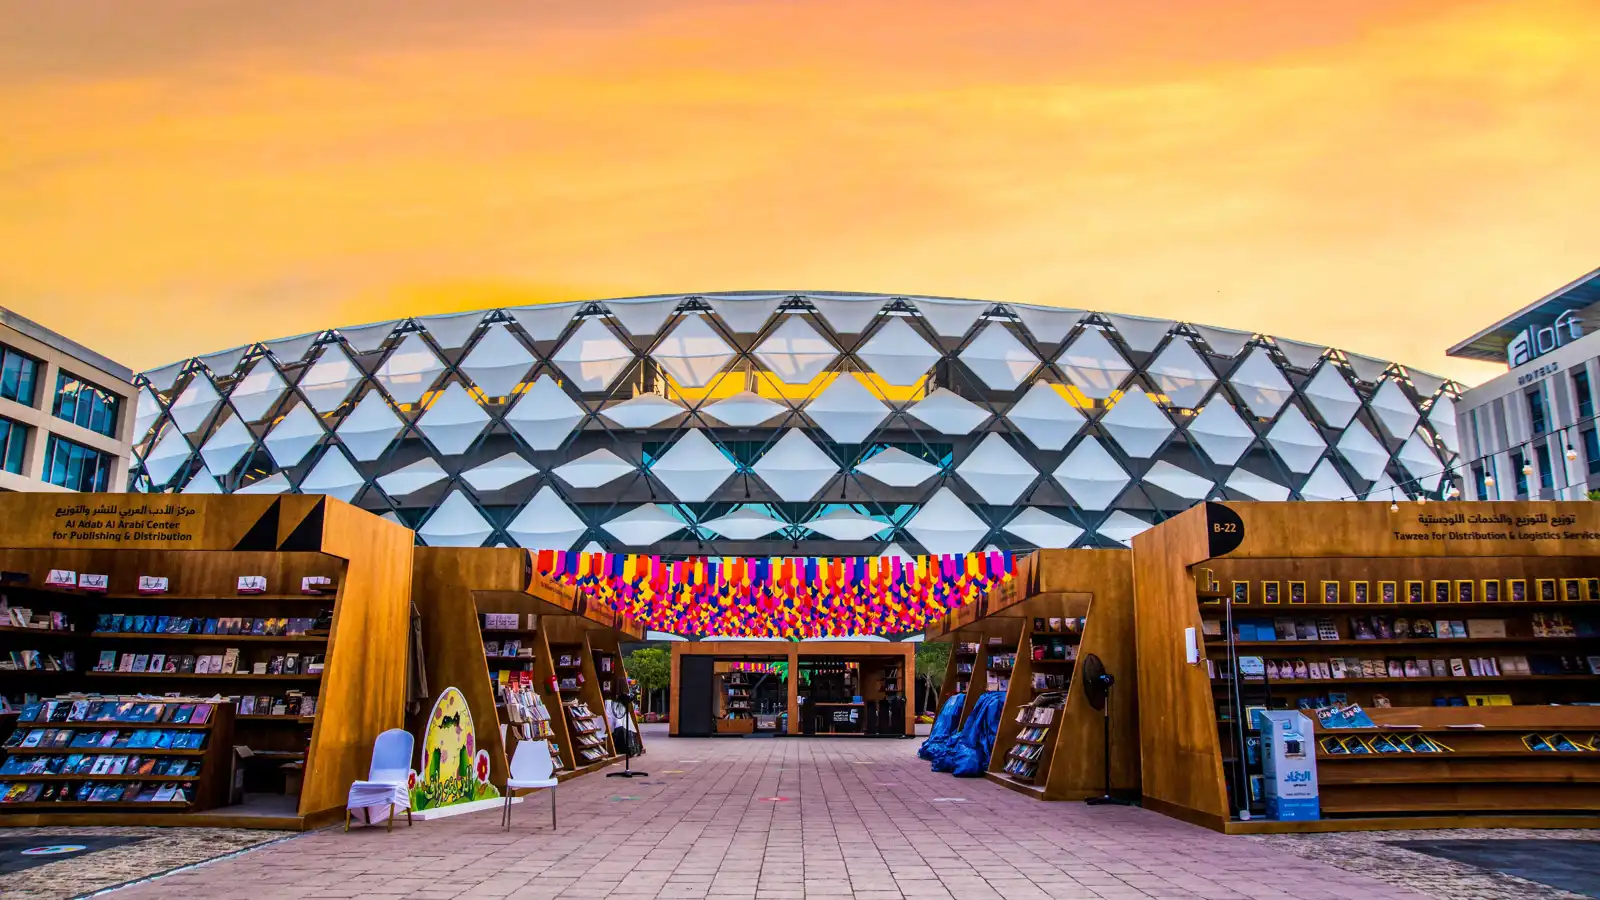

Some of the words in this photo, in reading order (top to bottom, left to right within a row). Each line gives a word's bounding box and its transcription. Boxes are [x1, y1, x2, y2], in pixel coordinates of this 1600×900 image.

[1507, 309, 1585, 369] aloft
[1517, 361, 1559, 386] HOTELS
[55, 504, 90, 517] والتوزيع
[93, 504, 118, 516] للنشر
[119, 504, 147, 519] العربي
[149, 504, 174, 517] الأدب
[175, 505, 196, 517] مركز
[65, 520, 76, 528] Al
[78, 520, 104, 529] Adab
[106, 520, 116, 528] Al
[118, 520, 145, 529] Arabi
[147, 521, 181, 529] Center
[1418, 513, 1465, 527] اللوجستية
[1467, 513, 1512, 526] والخدمات
[1515, 513, 1548, 527] للتوزيع
[1551, 514, 1576, 527] توزيع
[1213, 522, 1237, 533] B-22
[52, 531, 68, 540] for
[70, 531, 121, 542] Publishing
[124, 532, 131, 541] &
[134, 532, 192, 541] Distribution
[1394, 531, 1429, 540] Tawzea
[1432, 531, 1446, 540] for
[1448, 531, 1507, 540] Distribution
[1509, 531, 1515, 539] &
[1518, 531, 1560, 541] Logistics
